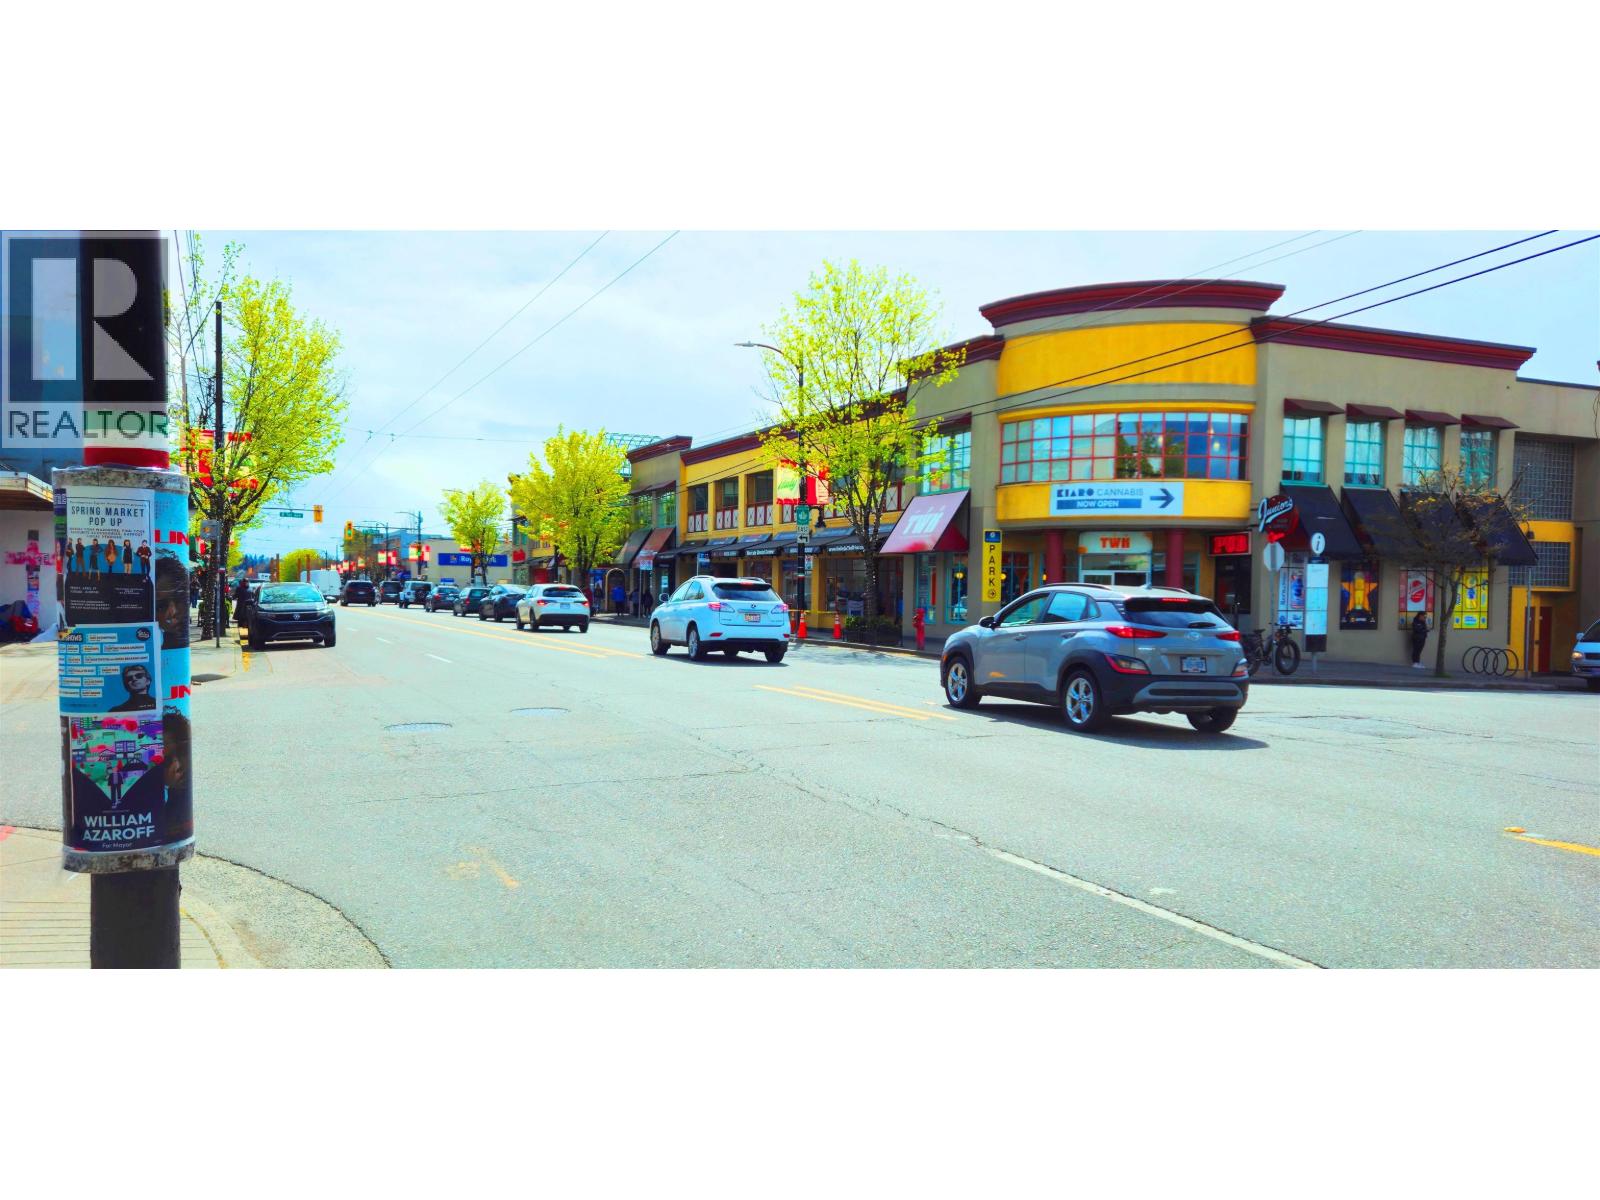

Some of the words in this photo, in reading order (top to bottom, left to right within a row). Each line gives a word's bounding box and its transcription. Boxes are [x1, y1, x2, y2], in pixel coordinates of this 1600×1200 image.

[1057, 487, 1095, 497] KIARO
[1096, 487, 1144, 497] CANNABIS
[1077, 499, 1098, 508] NOW
[1098, 499, 1120, 508] OPEN
[71, 506, 101, 516] SPRING
[105, 507, 145, 517] MARKET
[89, 517, 106, 526] POP
[110, 518, 123, 527] UP
[84, 812, 152, 827] WILLIAM
[82, 826, 155, 841] AZAROFF
